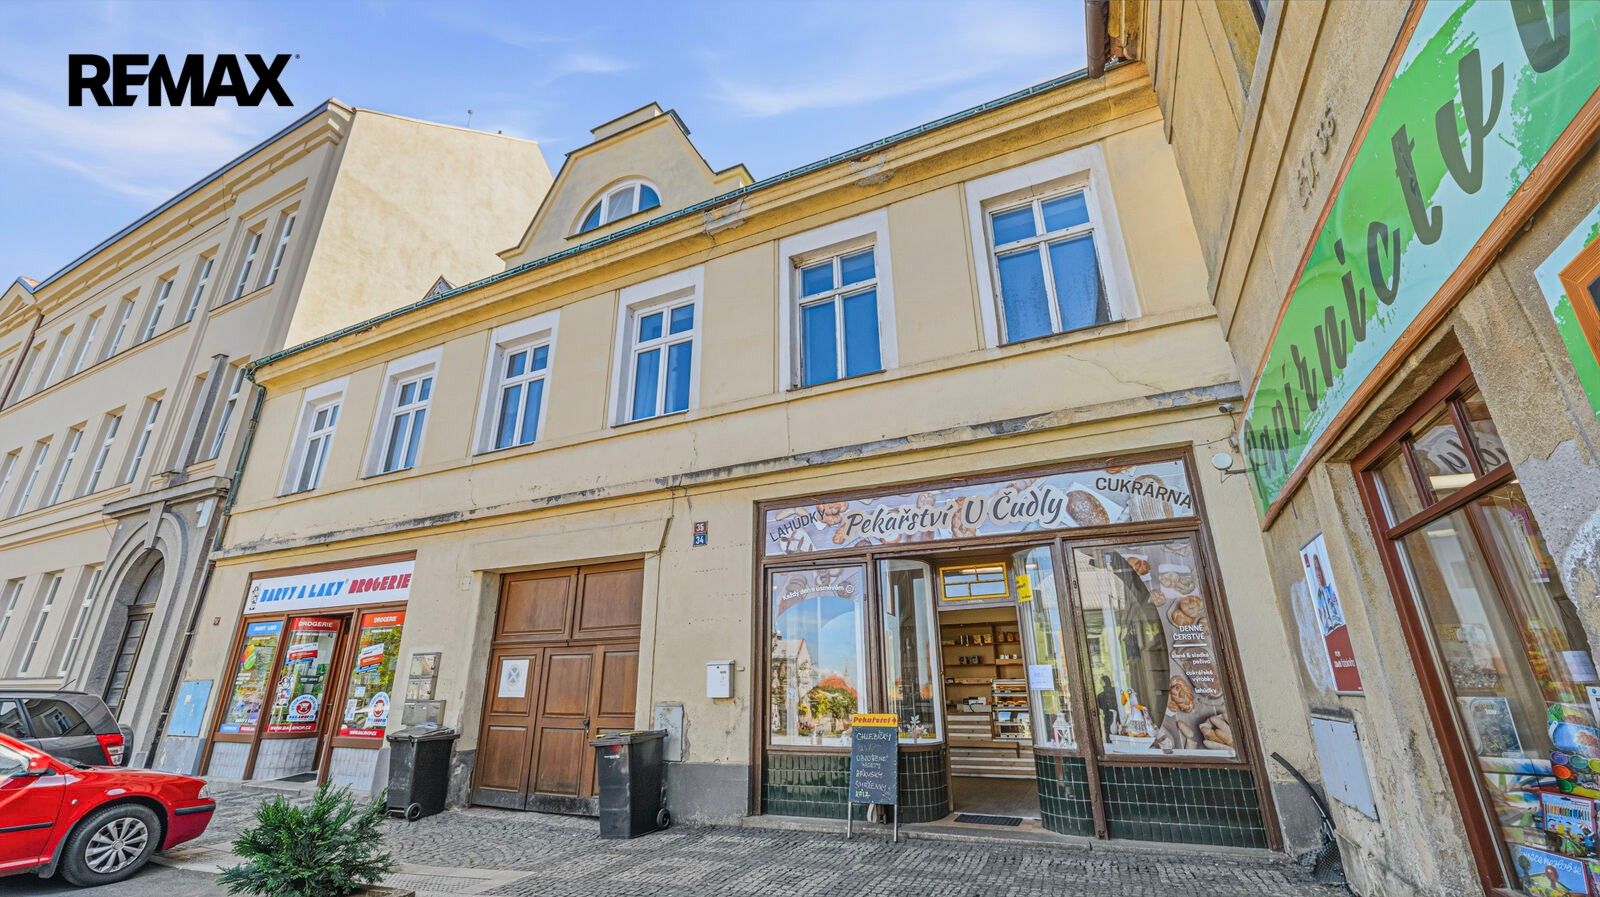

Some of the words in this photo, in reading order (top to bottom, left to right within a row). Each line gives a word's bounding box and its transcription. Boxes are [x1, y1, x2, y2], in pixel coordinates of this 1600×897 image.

[1095, 477, 1192, 509] CUKRÁRNA
[846, 505, 953, 536] Pekařství
[965, 499, 984, 524] U
[992, 488, 1063, 525] Čudly
[695, 523, 705, 532] 35
[695, 535, 704, 545] 34
[260, 586, 297, 603] BARVY
[297, 584, 307, 599] A
[308, 581, 345, 598] LAKY
[348, 573, 412, 594] DROGERIE
